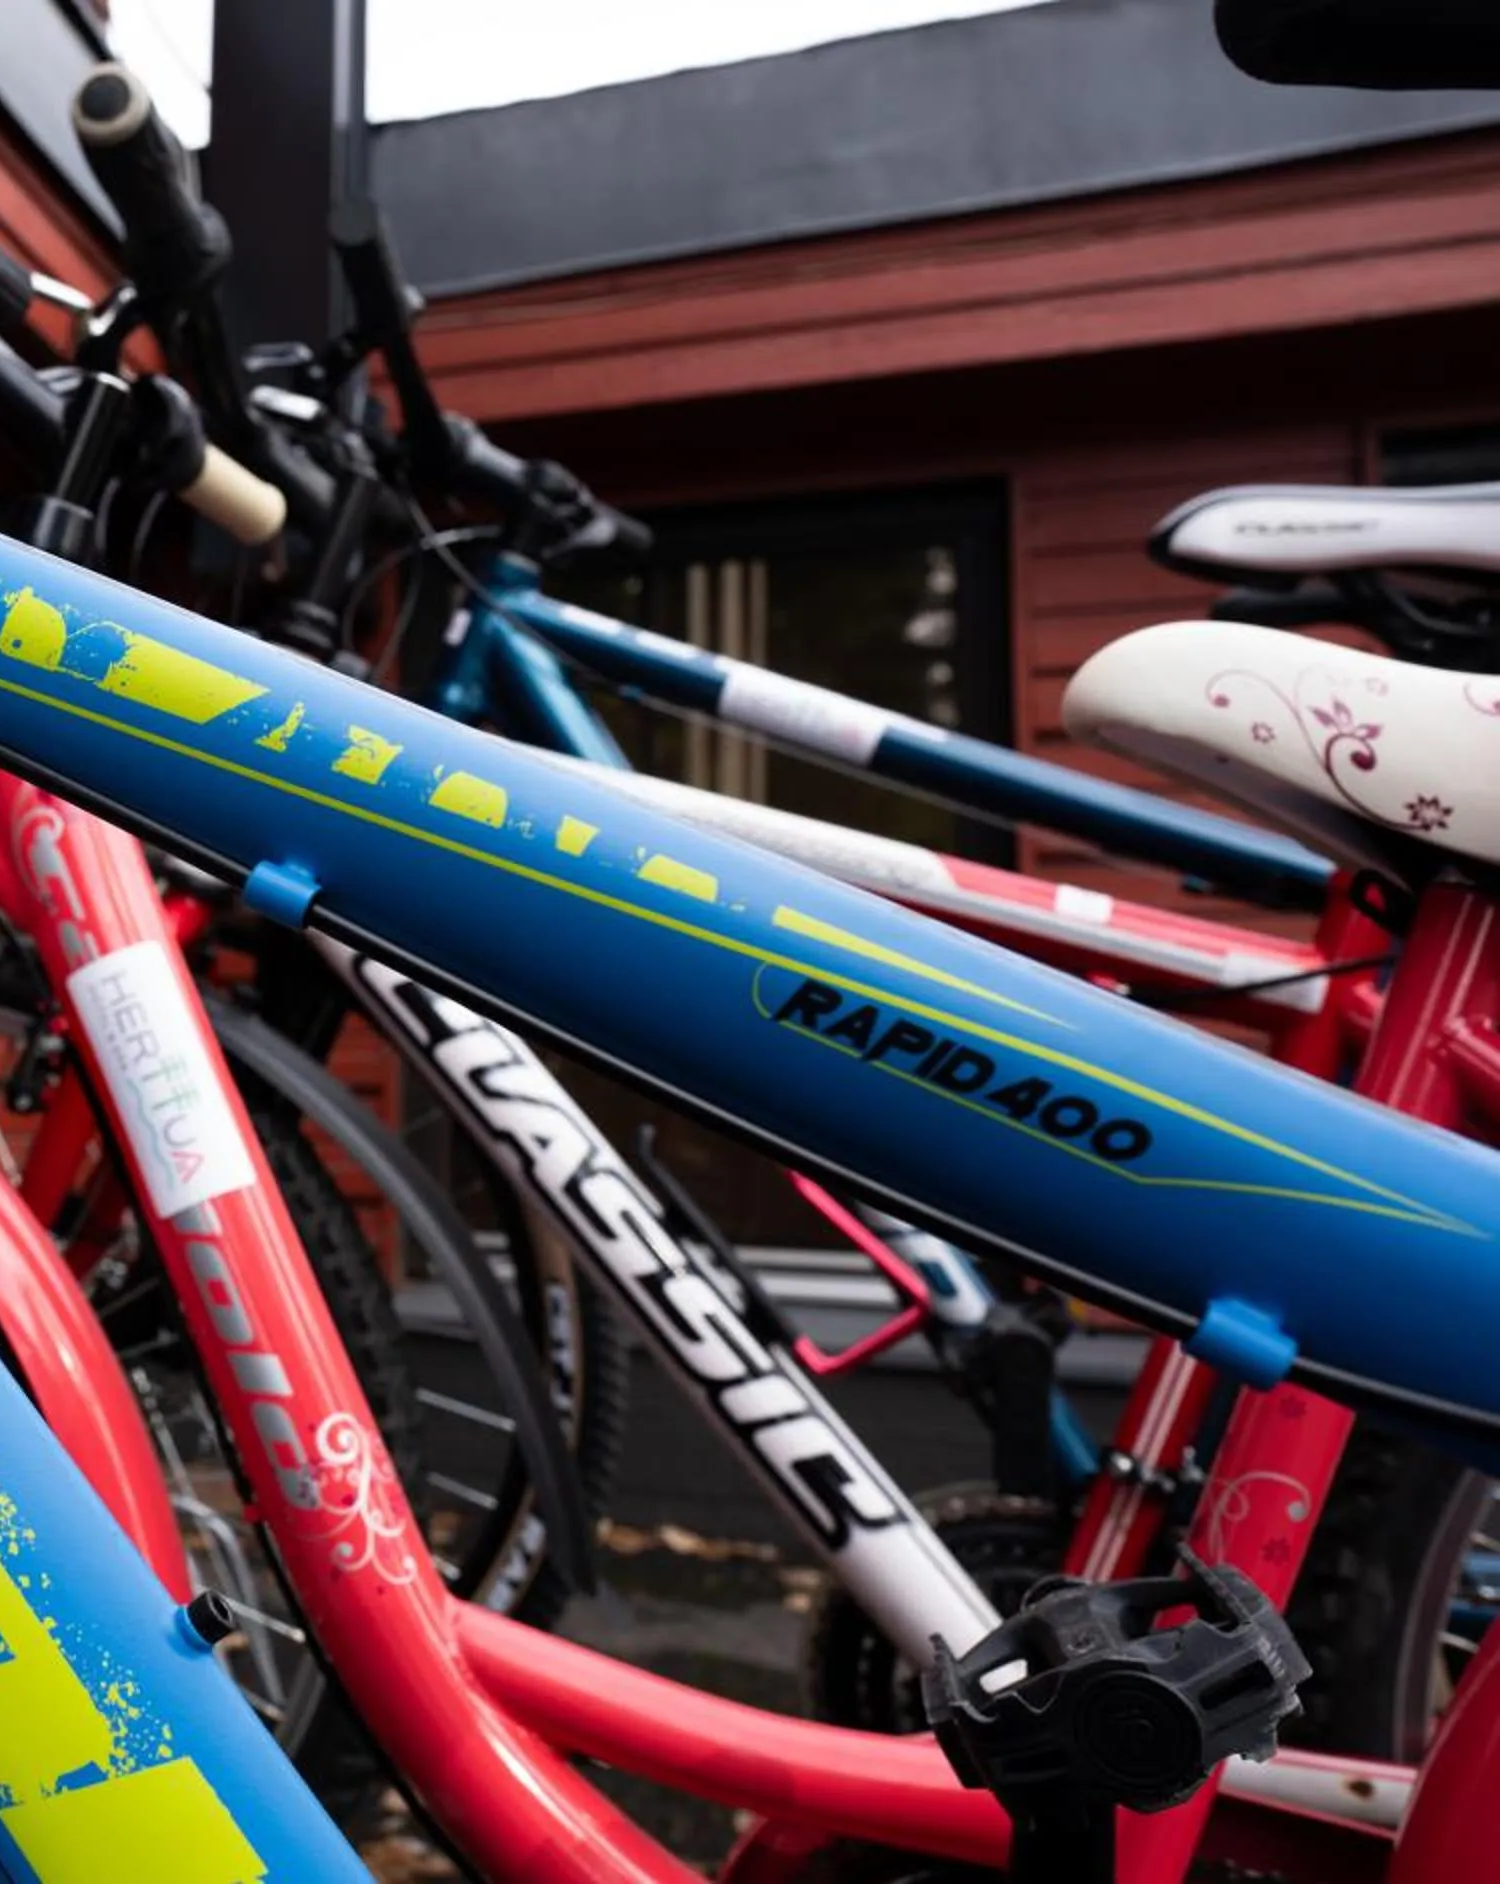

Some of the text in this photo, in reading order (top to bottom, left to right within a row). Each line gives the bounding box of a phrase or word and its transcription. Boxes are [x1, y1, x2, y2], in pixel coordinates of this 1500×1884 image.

[100, 969, 204, 1185] HERTTUA
[773, 978, 1153, 1161] RAPID 400
[352, 952, 906, 1552] CLASSIC
